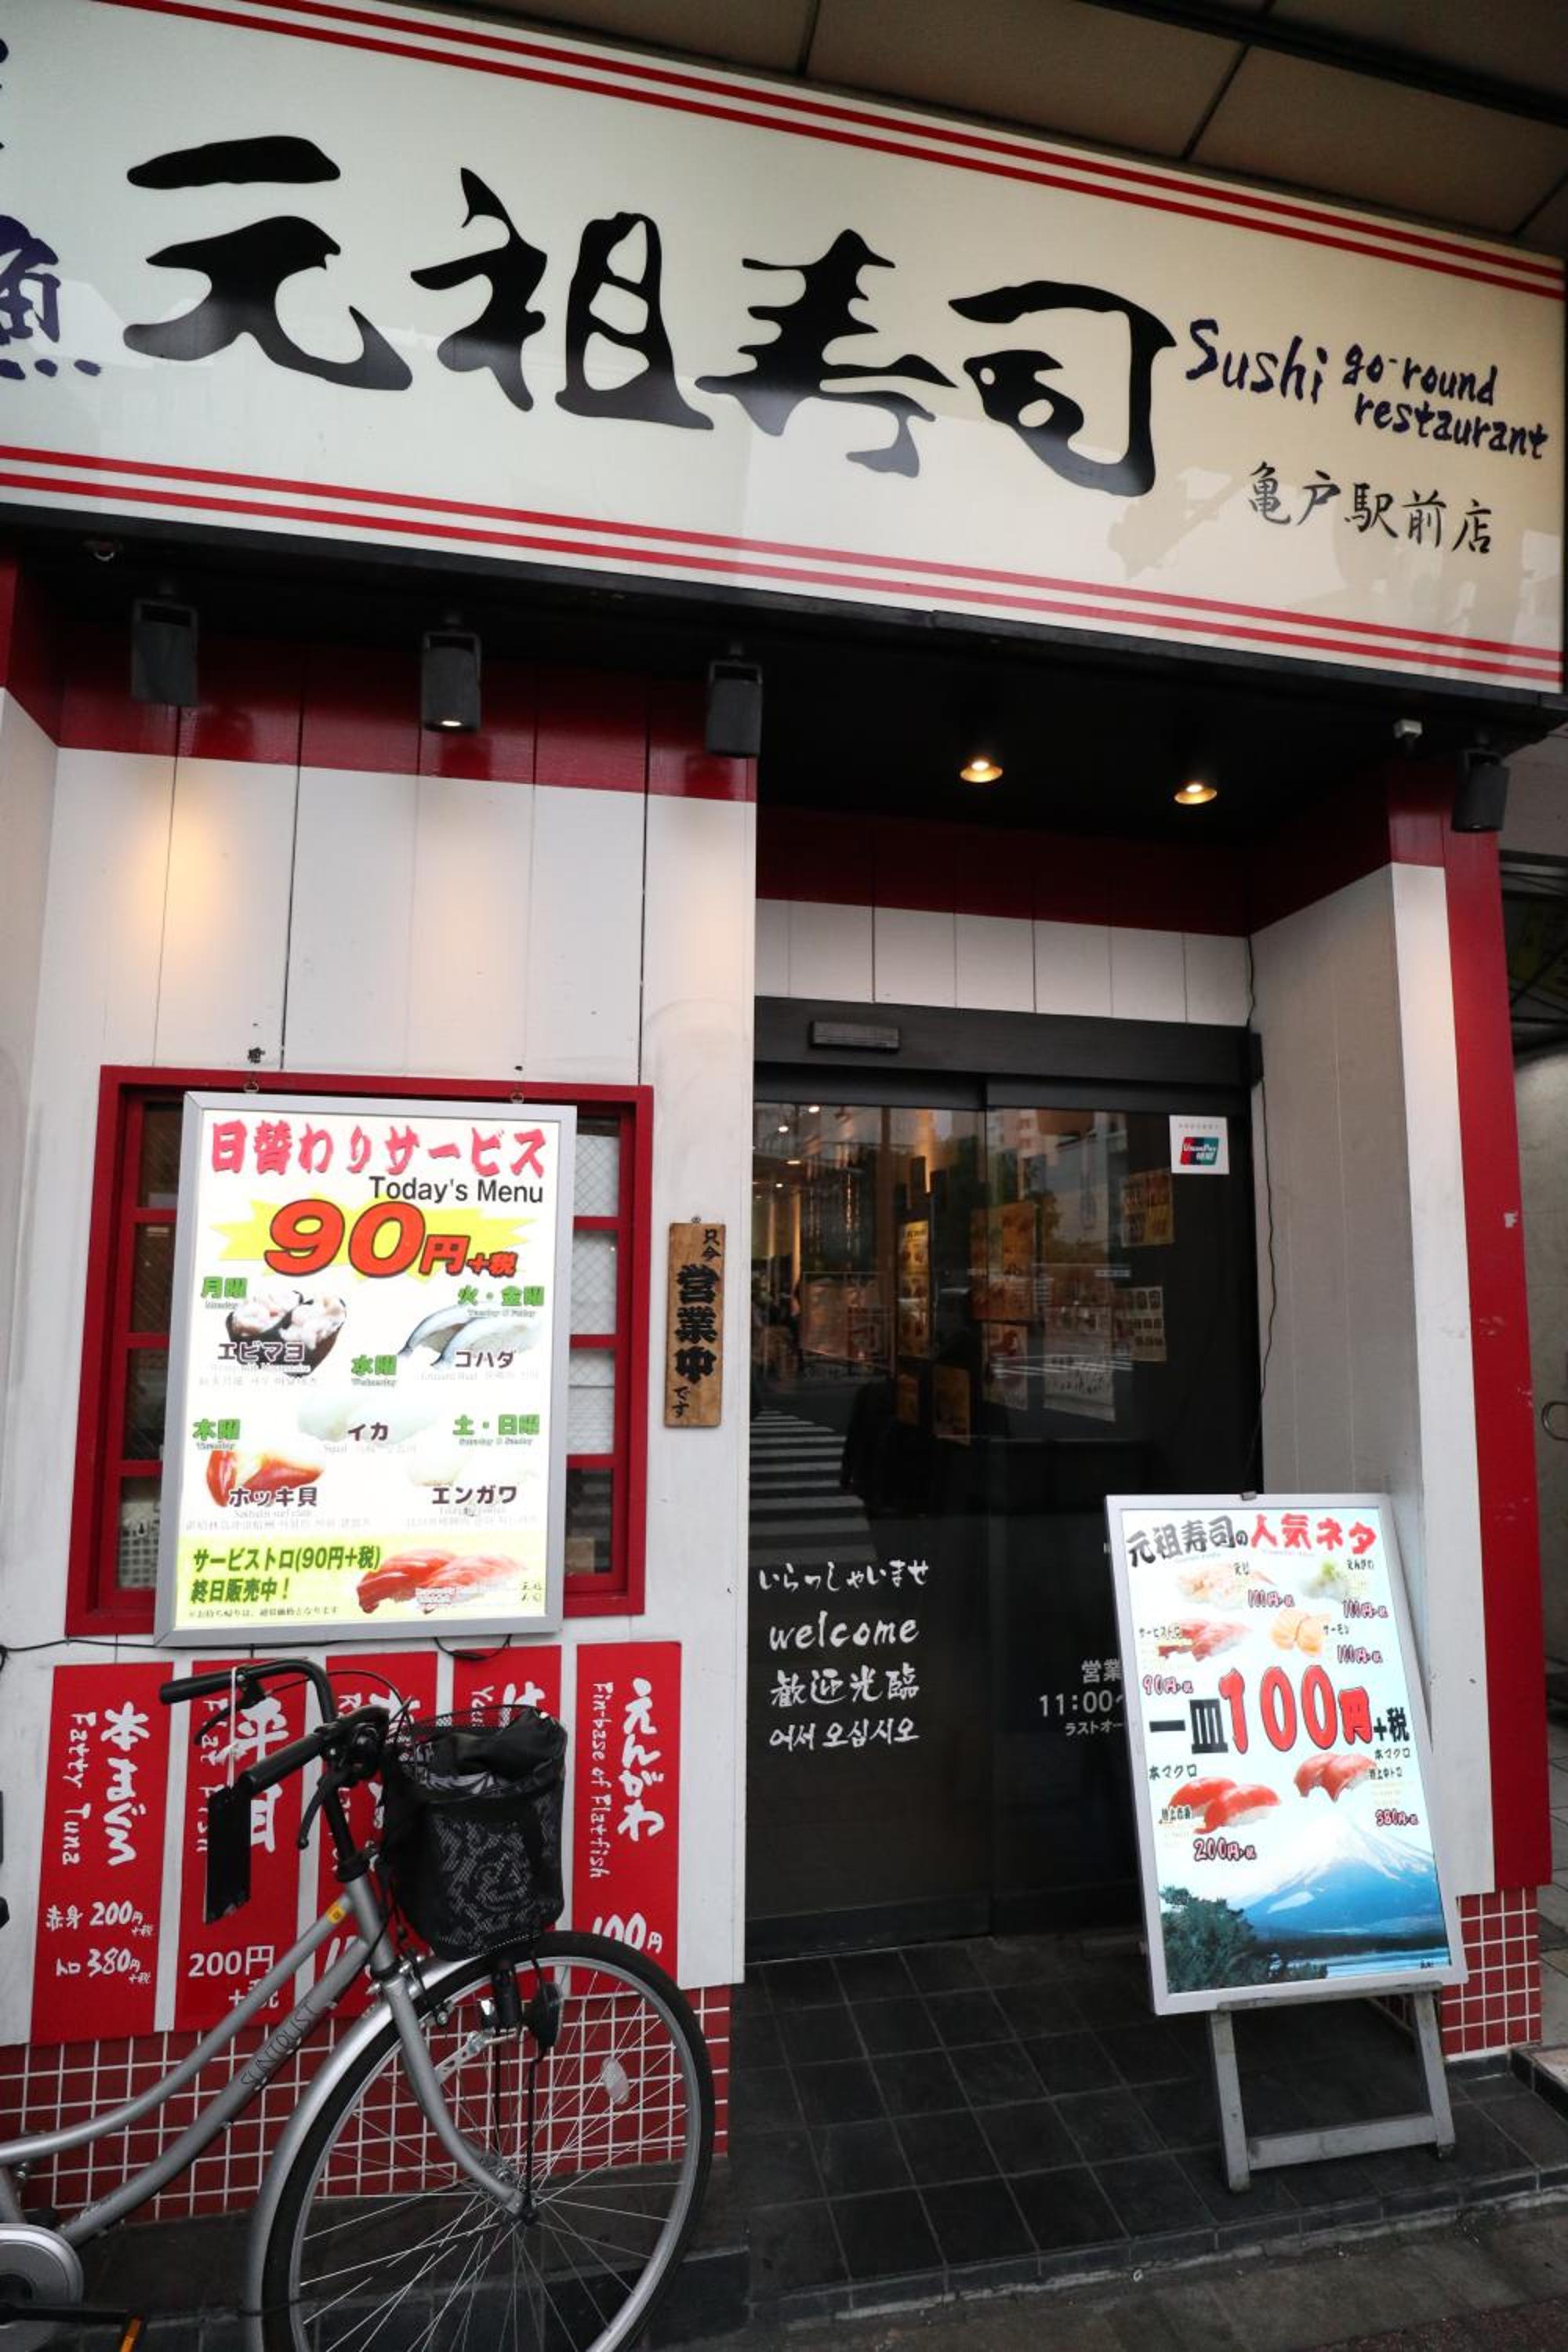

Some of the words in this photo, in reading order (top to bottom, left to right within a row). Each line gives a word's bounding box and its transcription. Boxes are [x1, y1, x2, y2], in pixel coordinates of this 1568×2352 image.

[123, 135, 1177, 497] 元祖寿司
[1185, 318, 1329, 405] Sushi
[1341, 343, 1498, 406] go-round
[1354, 392, 1549, 459] restaurant
[1250, 461, 1492, 554] 亀戸駅前店
[211, 1119, 546, 1178] 日替わりサービス
[368, 1175, 469, 1203] Today's
[477, 1178, 544, 1203] Menu
[674, 1263, 720, 1385] 営業中
[216, 1340, 306, 1362] エビマヨ
[455, 1349, 516, 1369] コハダ
[347, 1421, 389, 1442] イカ
[229, 1486, 318, 1507] ホッキ貝
[431, 1484, 517, 1504] エンガワ
[759, 1559, 930, 1592] いらっしゃいませ
[768, 1610, 920, 1651] welcome
[63, 1711, 96, 1788] Fatty
[768, 1722, 815, 1752] 어서
[822, 1717, 920, 1749] 오십시오
[617, 1678, 665, 1842] えんがわ
[100, 1700, 150, 1867] 本まぐろ
[591, 1769, 612, 1797] of
[62, 1802, 92, 1866] Tuna
[45, 1904, 84, 1932] 赤身
[89, 1900, 144, 1926] 200円
[56, 1957, 82, 1977] トロ
[87, 1947, 141, 1978] 380円
[188, 1944, 275, 1978] 200円
